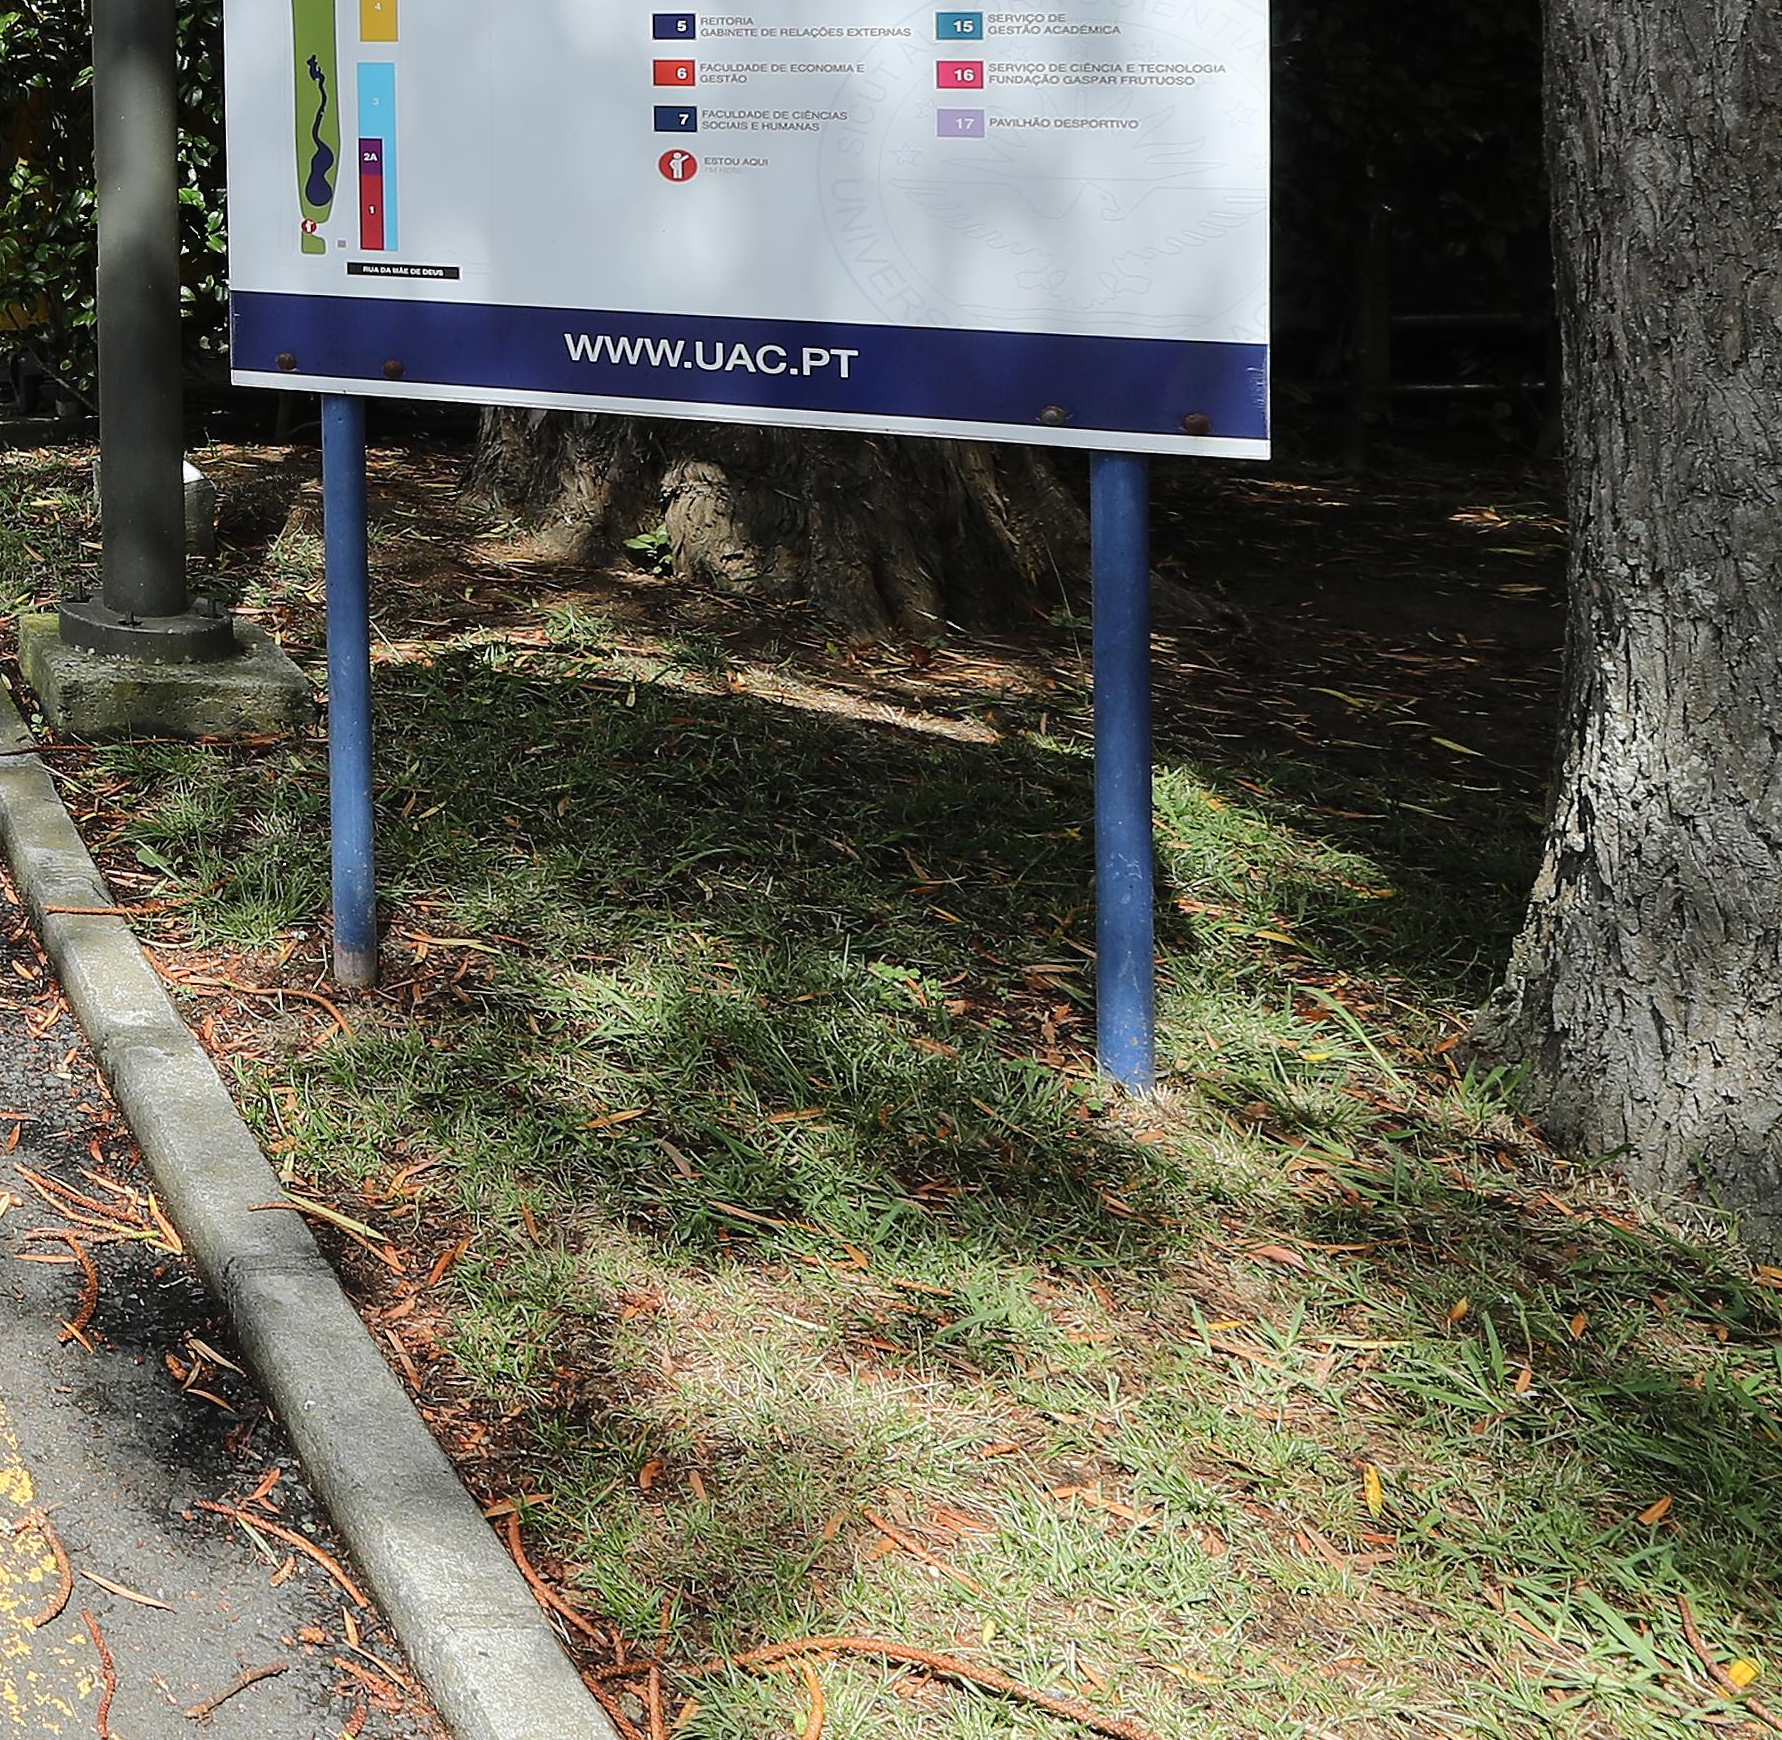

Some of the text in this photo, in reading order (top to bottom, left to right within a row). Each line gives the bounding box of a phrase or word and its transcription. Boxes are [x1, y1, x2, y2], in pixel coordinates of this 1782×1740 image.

[701, 18, 754, 26] REITORIA
[988, 14, 1066, 25] SERVIÇO DE
[677, 21, 686, 31] 5
[953, 21, 973, 32] 15
[988, 23, 1121, 35] GESTÃO ACADÉMICA
[701, 27, 911, 38] GABINETE DE RELAÇÕES EXTERNAS
[700, 64, 864, 73] FACULDADE DE ECONOMIA E
[988, 62, 1226, 74] SERVIÇO DE CIÊNCIA E TECNOLOGIA
[677, 69, 687, 79] 6
[700, 73, 747, 84] GESTÃO
[954, 69, 974, 81] 16
[989, 74, 1195, 86] FUNDAÇÃO GASPAR FRUTUOSO
[679, 115, 688, 125] 7
[702, 110, 847, 120] FACULDADE DE CIÊNCIAS
[702, 121, 747, 130] SOCIAIS
[762, 122, 820, 131] HUMANAS
[956, 118, 974, 129] 17
[989, 117, 1139, 128] PAVILHÃO DESPORTIVO
[364, 152, 378, 161] 2A
[704, 157, 739, 165] ESTOU
[563, 333, 859, 378] WWW.UAC.PT
